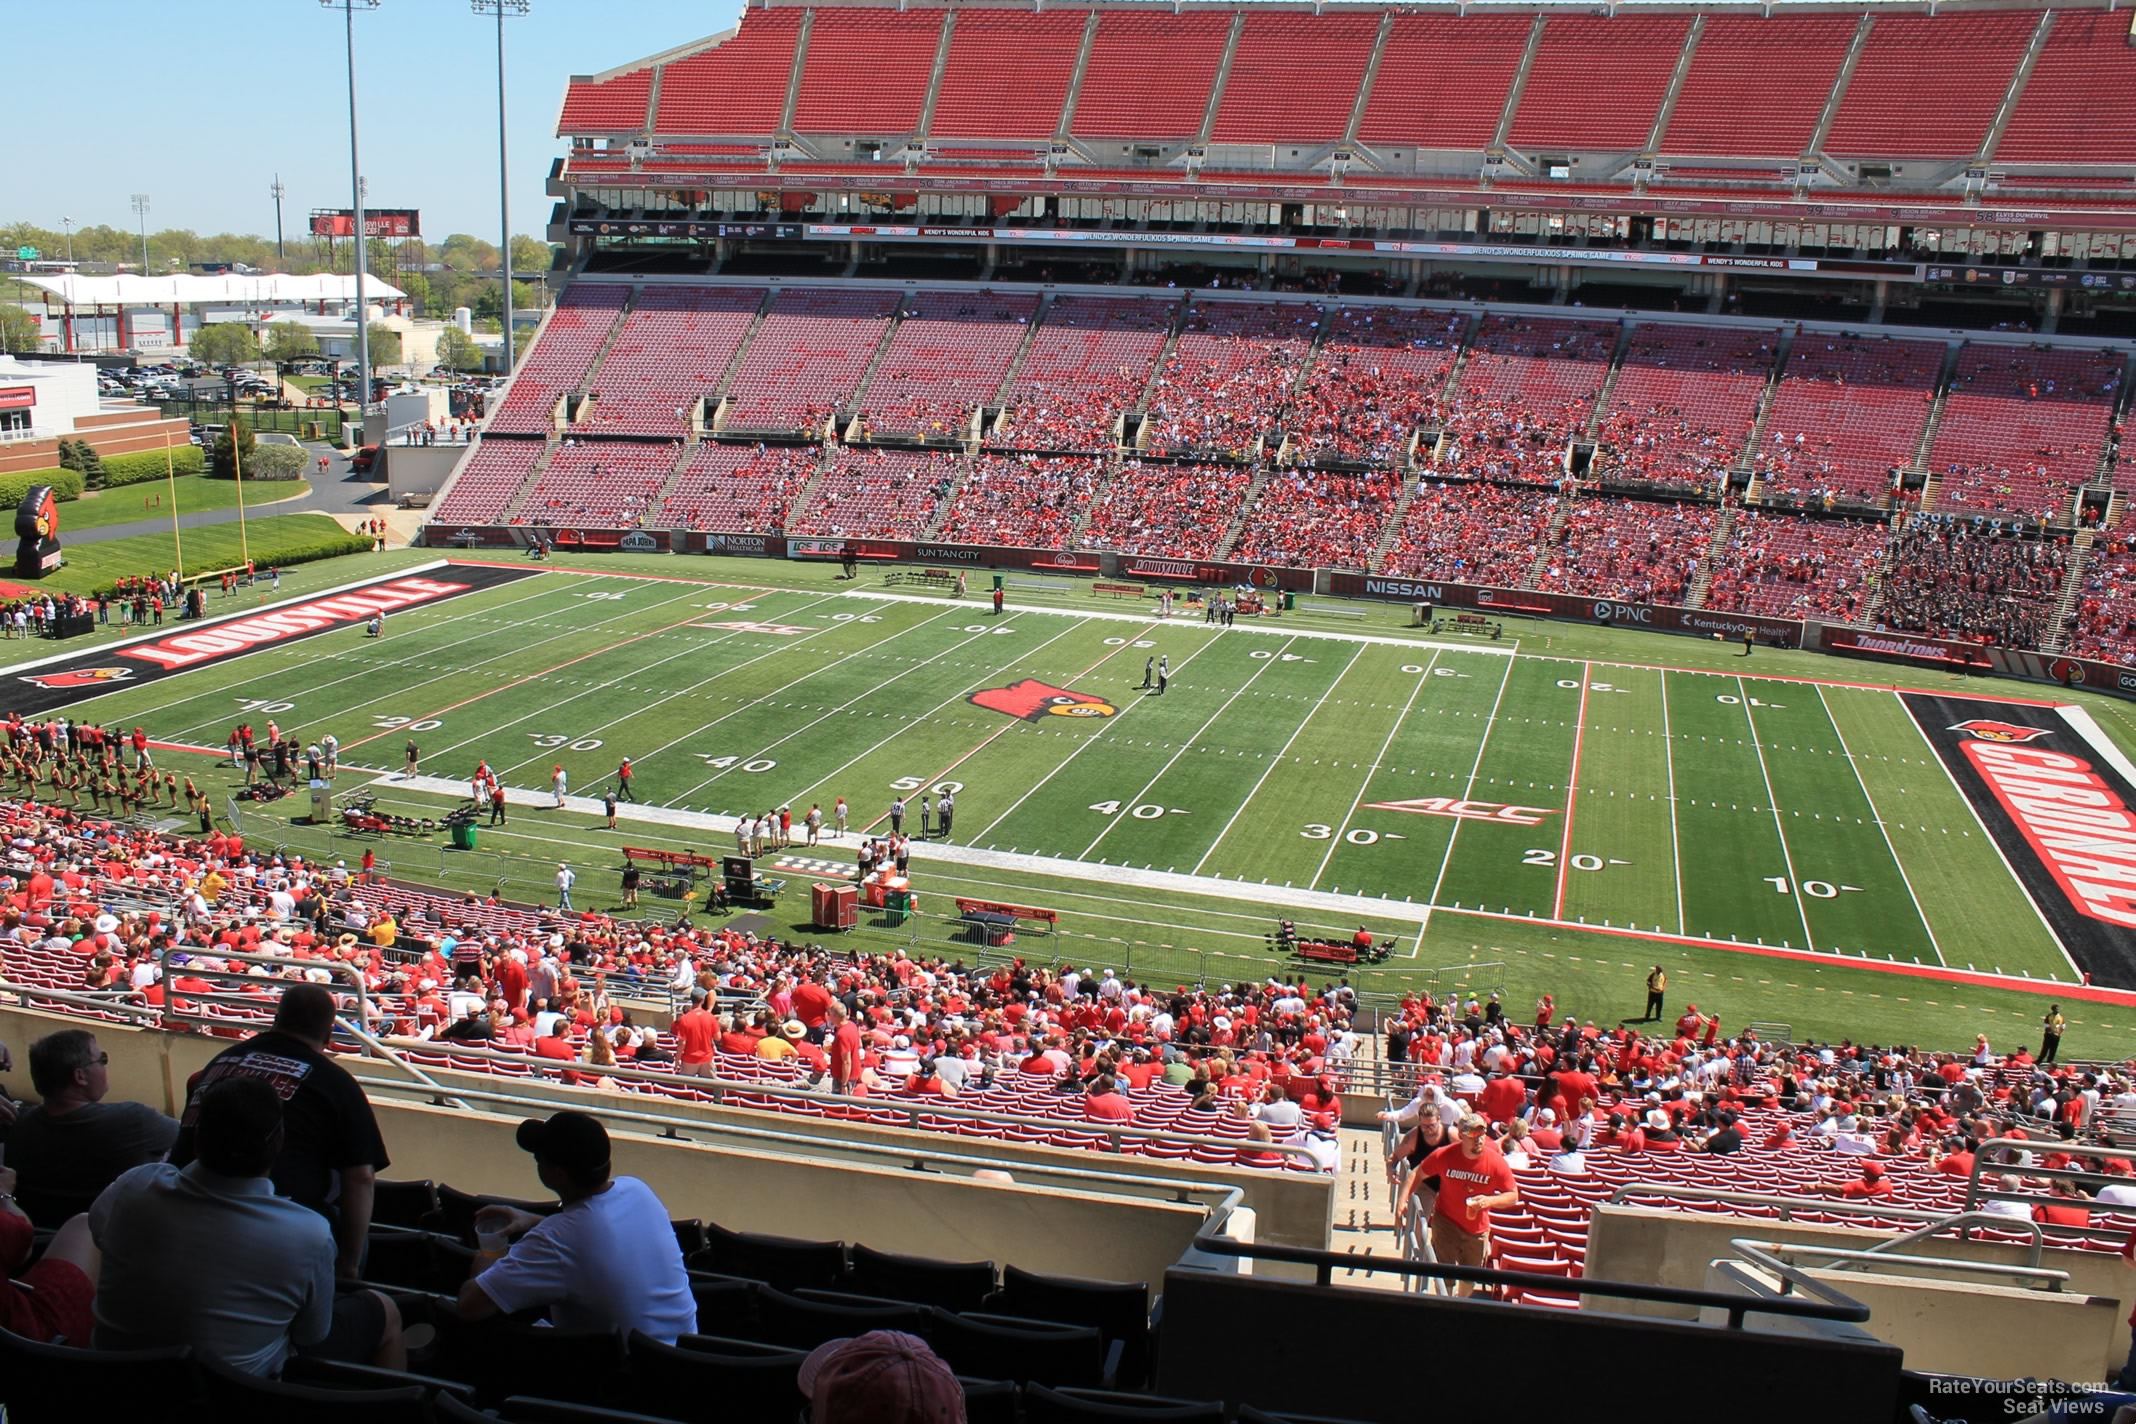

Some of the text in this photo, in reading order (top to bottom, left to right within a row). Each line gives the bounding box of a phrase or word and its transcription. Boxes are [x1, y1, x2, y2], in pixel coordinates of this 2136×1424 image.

[566, 175, 577, 183] 16
[703, 176, 716, 184] 26
[1064, 183, 1077, 191] 56
[1118, 184, 1131, 192] 77
[1194, 186, 1205, 194] 10
[1270, 188, 1283, 197] 75
[1341, 191, 1355, 199] 34
[1568, 198, 1584, 207] 72
[1806, 206, 1823, 216] 99
[1890, 208, 1900, 218] 9
[1976, 211, 1994, 222] 58
[924, 228, 947, 236] WENDY'S
[1083, 232, 1112, 240] WENDY'S
[1113, 233, 1150, 241] WONDERFUL
[1472, 247, 1502, 255] WENDY'S
[1503, 248, 1543, 256] WONDERFUL
[1562, 250, 1588, 258] SPRING
[1734, 259, 1768, 267] WONDERFUL
[727, 535, 766, 546] NORTON
[727, 544, 765, 552] HEALTHCARE
[916, 548, 980, 561] SUN TAN CITY
[1134, 559, 1194, 576] LOUISVILLE
[1366, 580, 1442, 599] NISSAN
[1615, 605, 1653, 624] PNC
[146, 578, 464, 667] LOUISVILLE
[239, 699, 295, 713] 10
[371, 715, 443, 732] 20
[532, 734, 604, 752] 30
[704, 756, 778, 773] 40
[889, 776, 964, 796] 50
[1086, 799, 1164, 821] 40
[1362, 797, 1562, 826] ACC
[1297, 822, 1380, 846] 30
[1521, 848, 1606, 872] 20
[1763, 875, 1841, 899] 10
[254, 1053, 301, 1068] COUCH
[1446, 1168, 1491, 1185] LOUISVILLE
